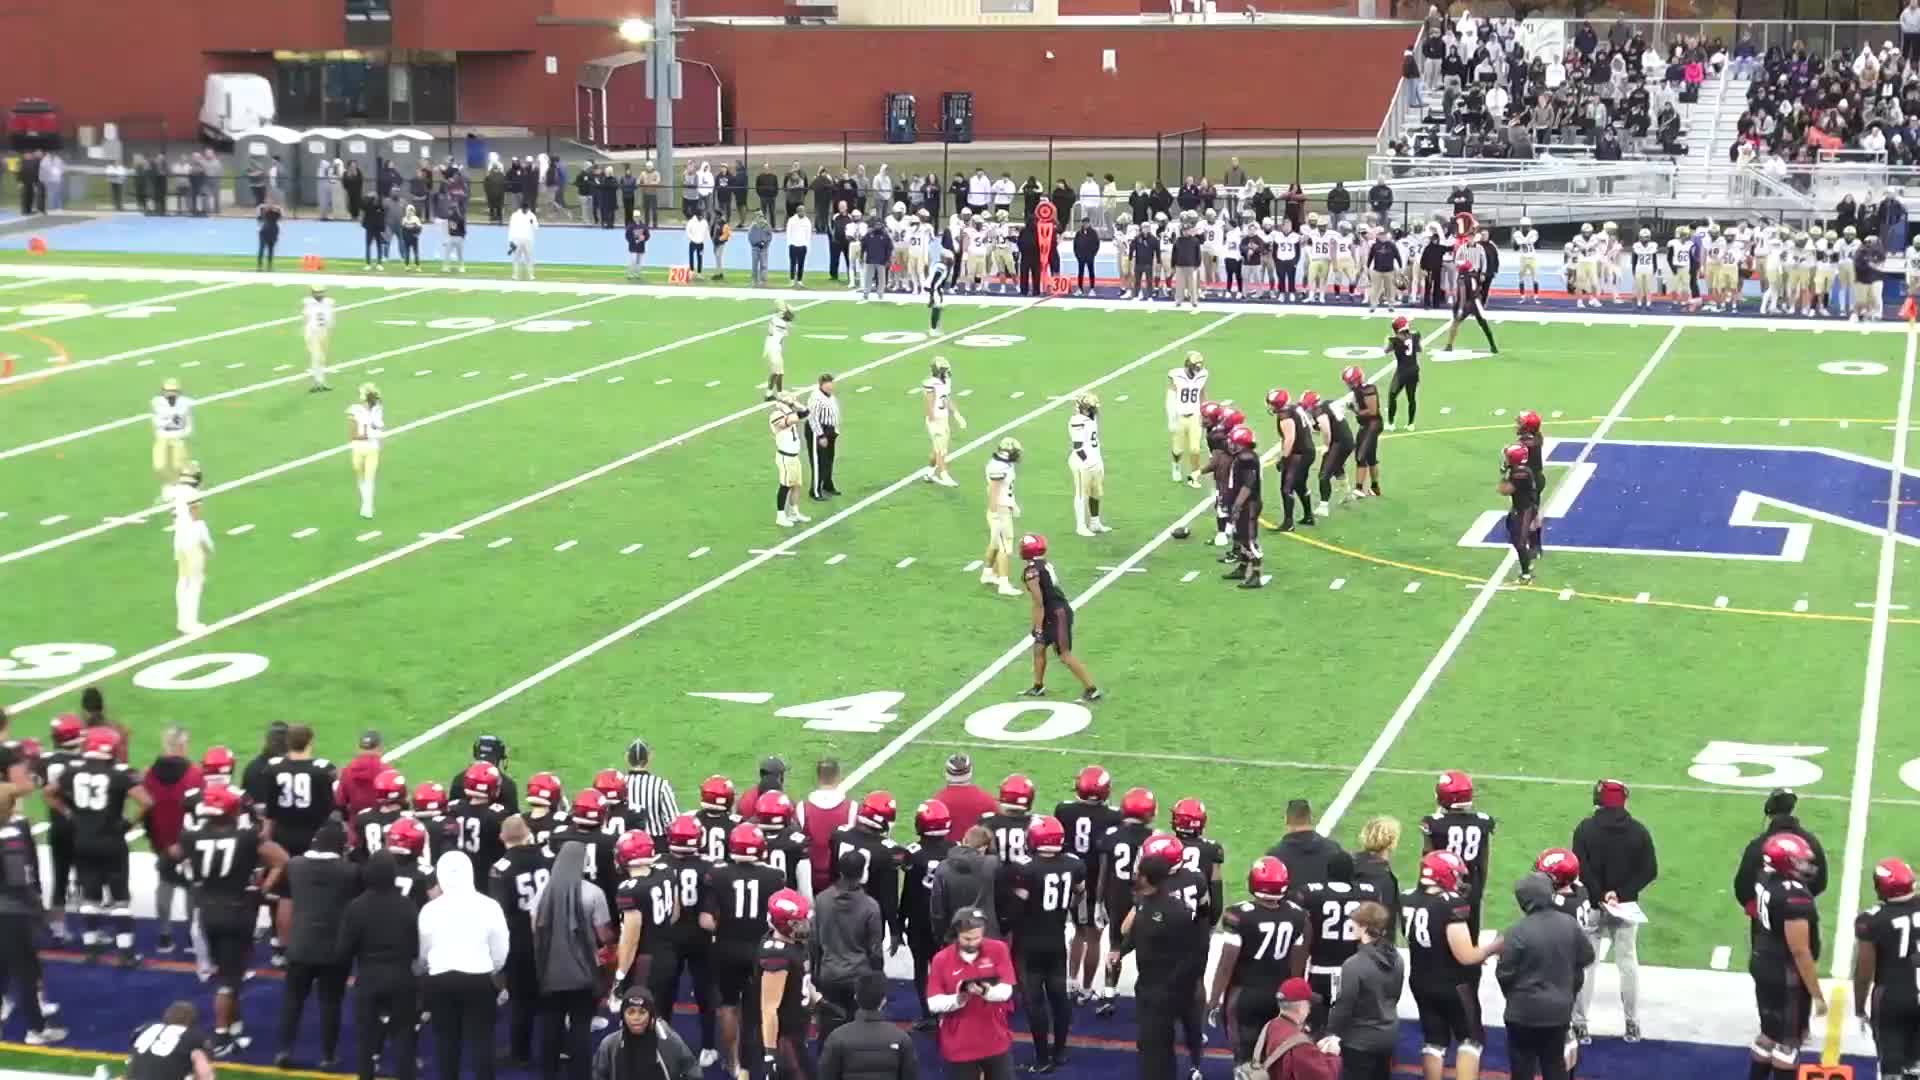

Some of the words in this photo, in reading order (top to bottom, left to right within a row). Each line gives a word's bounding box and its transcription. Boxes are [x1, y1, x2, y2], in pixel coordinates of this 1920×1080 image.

[1315, 241, 1329, 254] 66
[1052, 277, 1068, 292] 30
[964, 700, 1092, 741] 0
[1687, 740, 1829, 788] 5
[73, 772, 110, 810] 63
[276, 772, 311, 809] 39
[457, 816, 481, 852] 13
[995, 828, 1026, 863] 18
[1075, 816, 1091, 853] 8
[1446, 825, 1481, 861] 88
[195, 838, 236, 878] 77
[732, 879, 760, 919] 11
[1043, 871, 1073, 911] 61
[1322, 900, 1361, 940] 22
[1402, 906, 1432, 948] 78
[1254, 921, 1294, 960] 70
